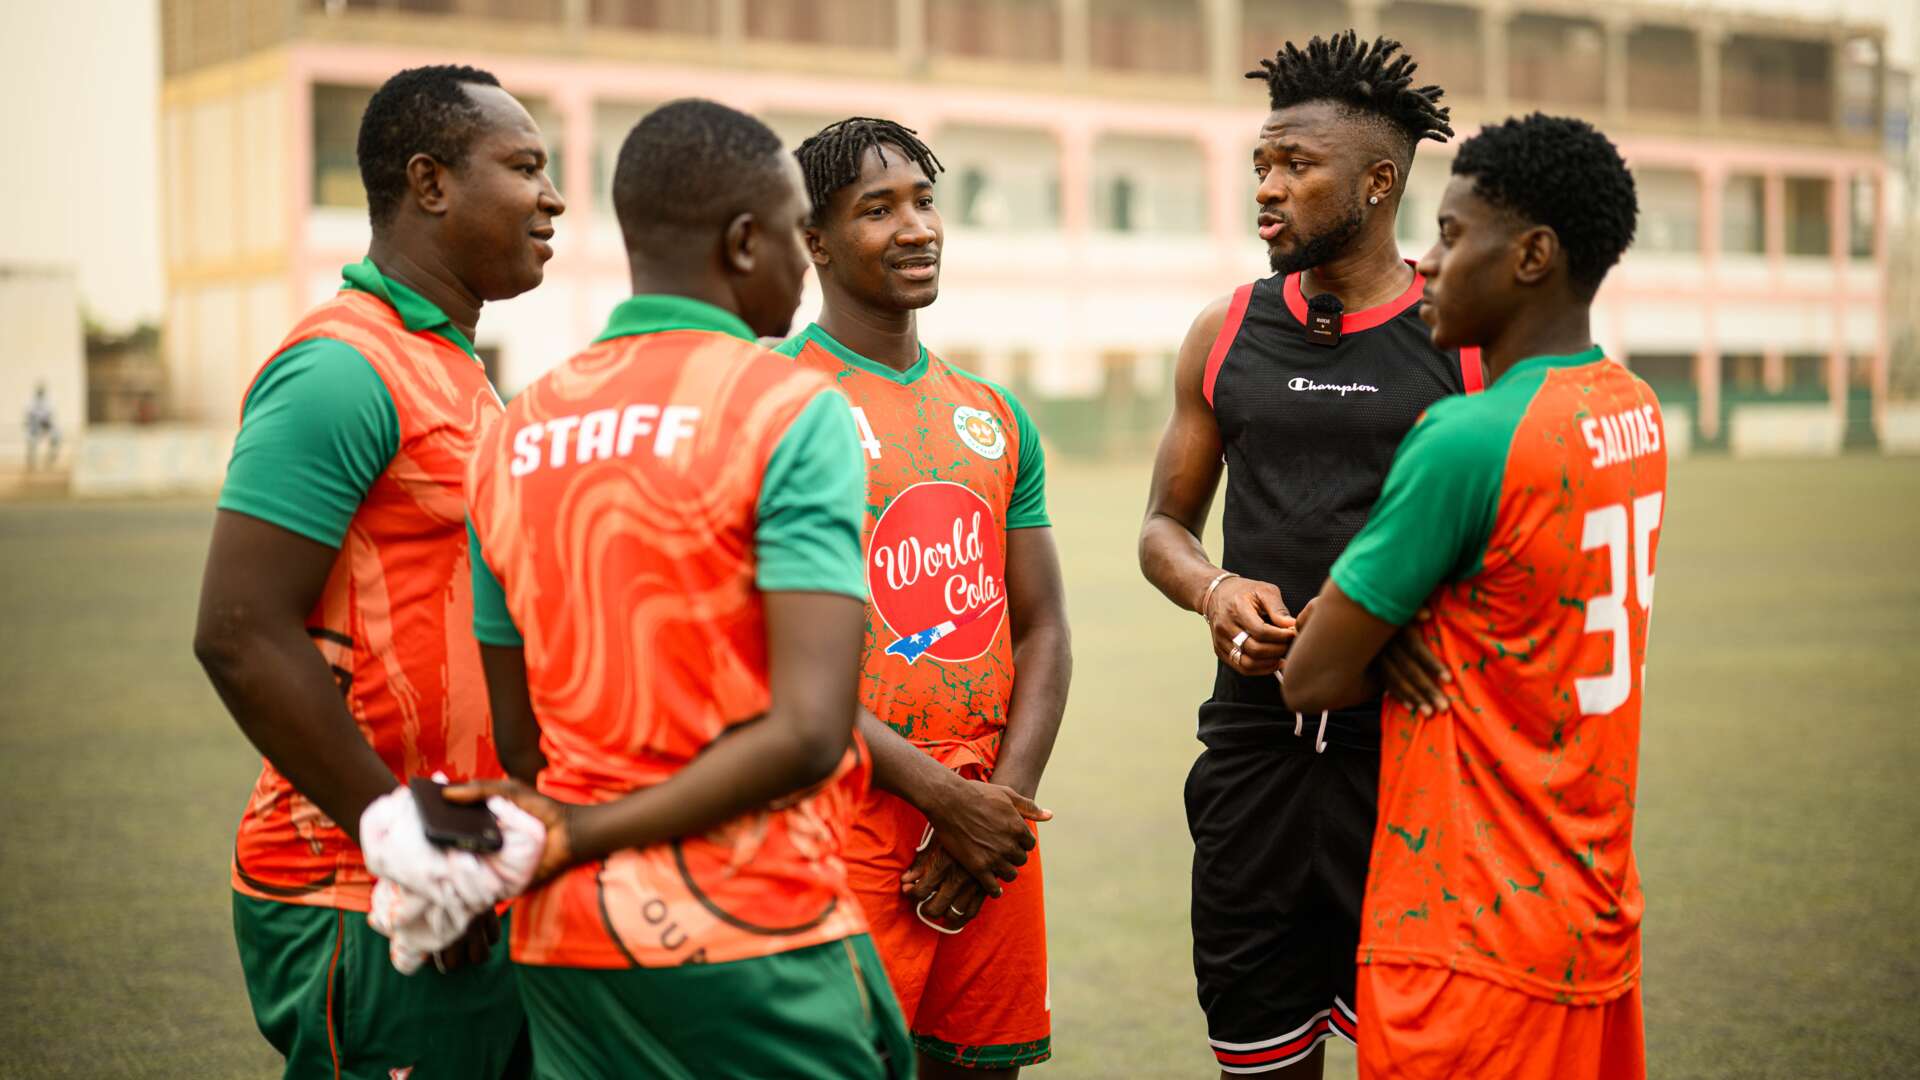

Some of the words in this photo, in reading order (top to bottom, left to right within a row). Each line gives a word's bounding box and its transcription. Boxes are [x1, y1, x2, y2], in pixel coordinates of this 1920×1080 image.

[1288, 377, 1379, 396] Champion
[511, 404, 700, 477] STAFF
[1581, 404, 1660, 469] SALITAS
[874, 511, 983, 590] World
[944, 563, 999, 615] Cola
